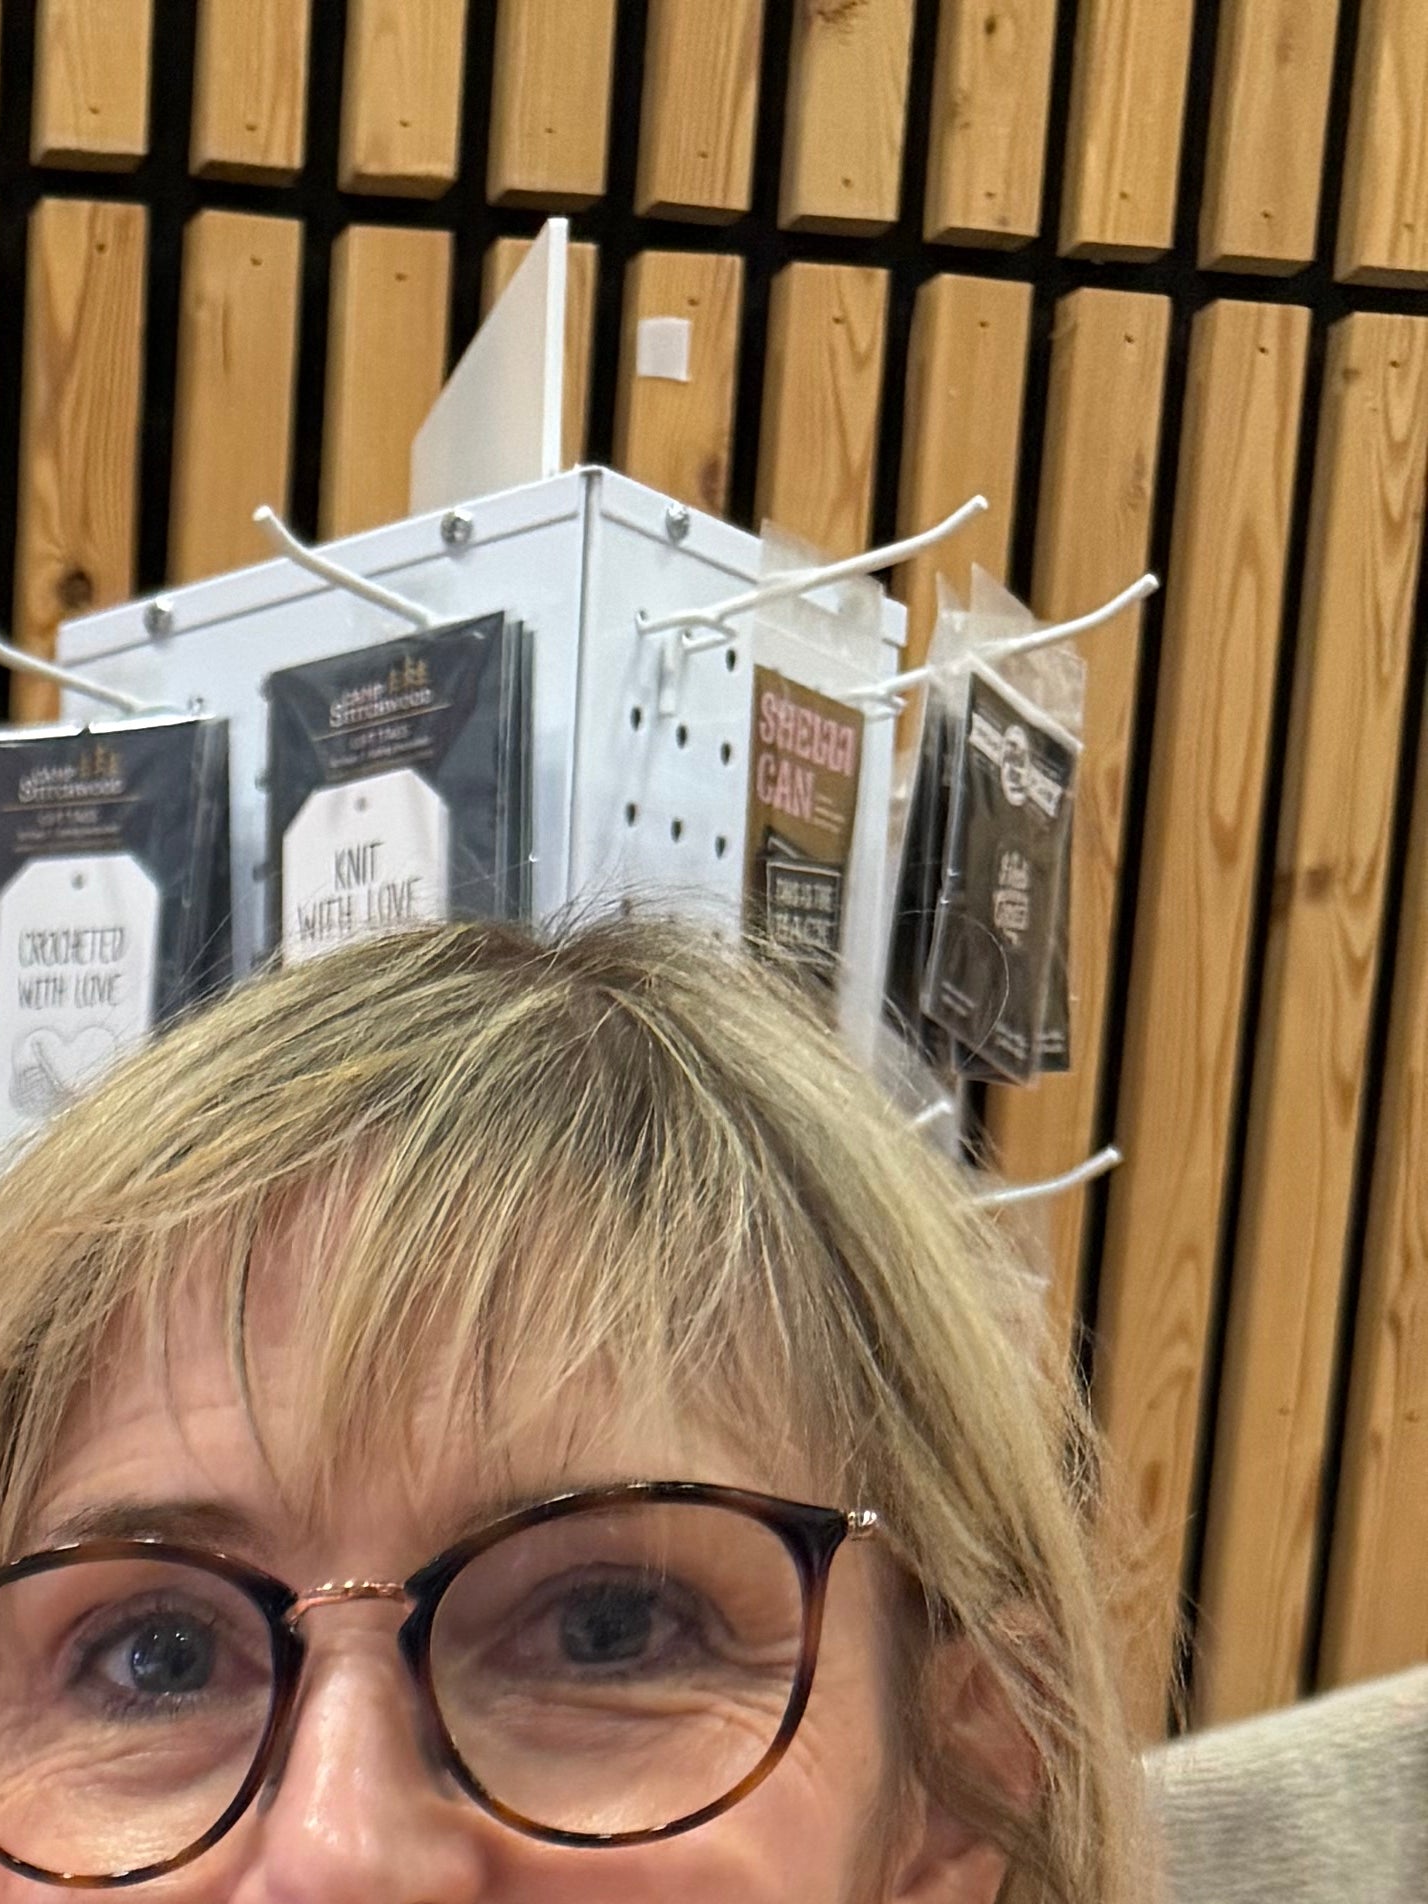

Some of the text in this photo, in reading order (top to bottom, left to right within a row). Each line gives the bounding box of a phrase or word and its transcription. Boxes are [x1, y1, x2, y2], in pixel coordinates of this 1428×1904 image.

[756, 753, 815, 823] CAN
[333, 841, 385, 891] KNIT
[297, 877, 422, 942] WITH LOVE
[18, 926, 126, 969] CROCHETED
[17, 972, 123, 1010] WITH LOVE
